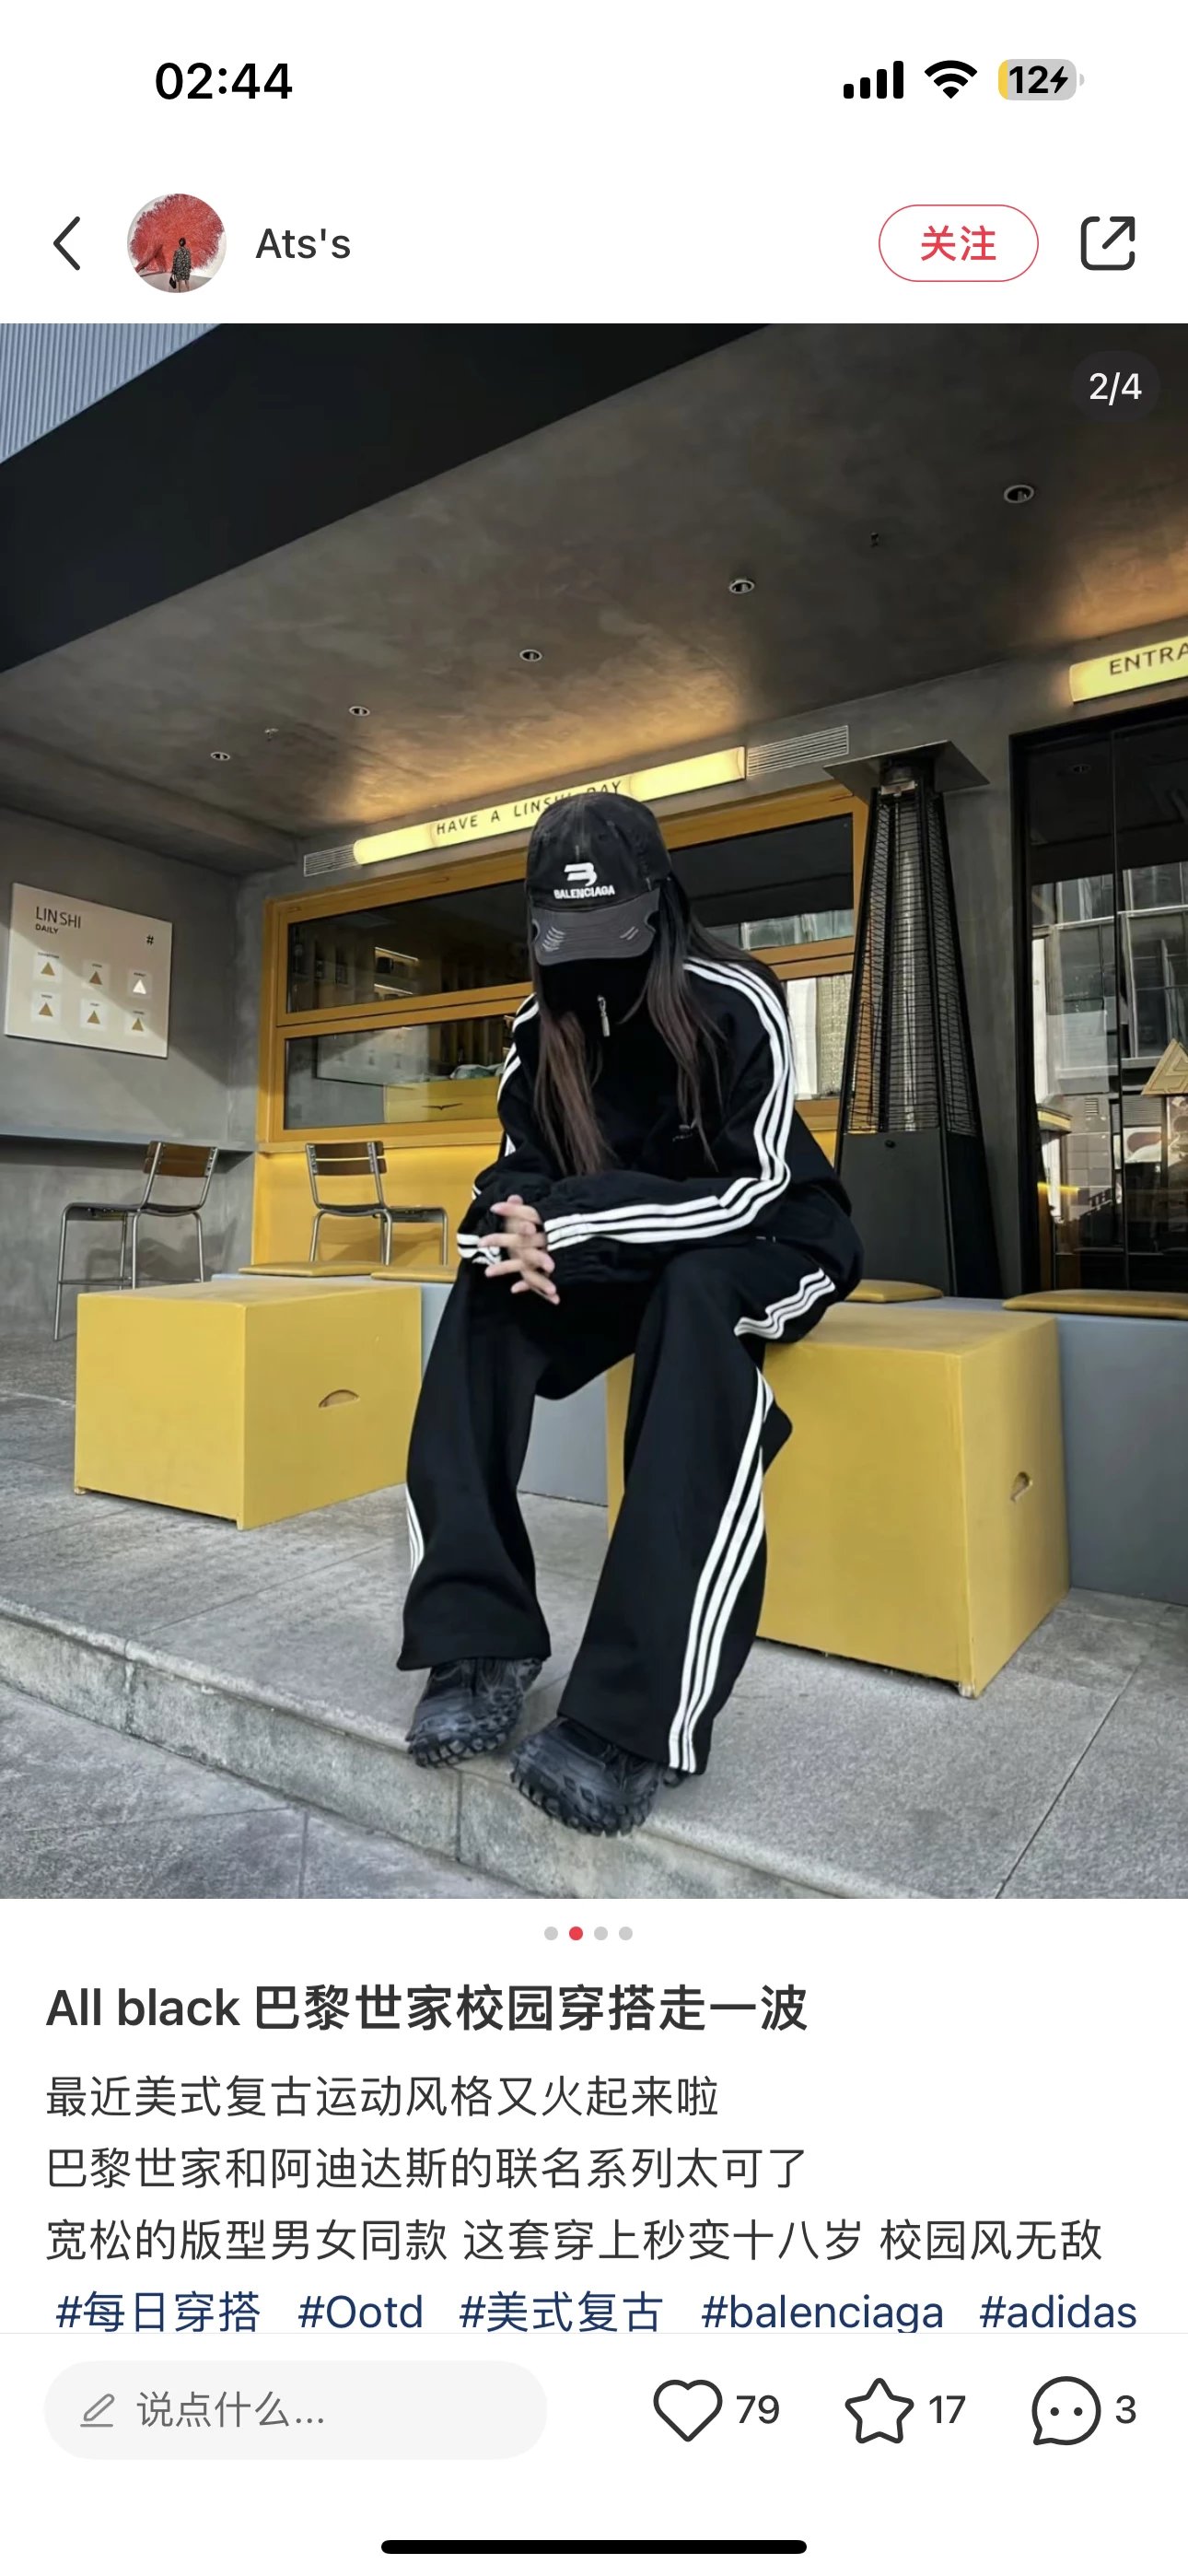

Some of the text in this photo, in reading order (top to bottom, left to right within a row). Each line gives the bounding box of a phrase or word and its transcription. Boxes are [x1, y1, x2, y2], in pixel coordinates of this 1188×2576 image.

[437, 814, 478, 835] HAVE
[491, 810, 500, 823] A
[553, 884, 615, 899] BALENCIAGA
[36, 924, 59, 934] DAILY
